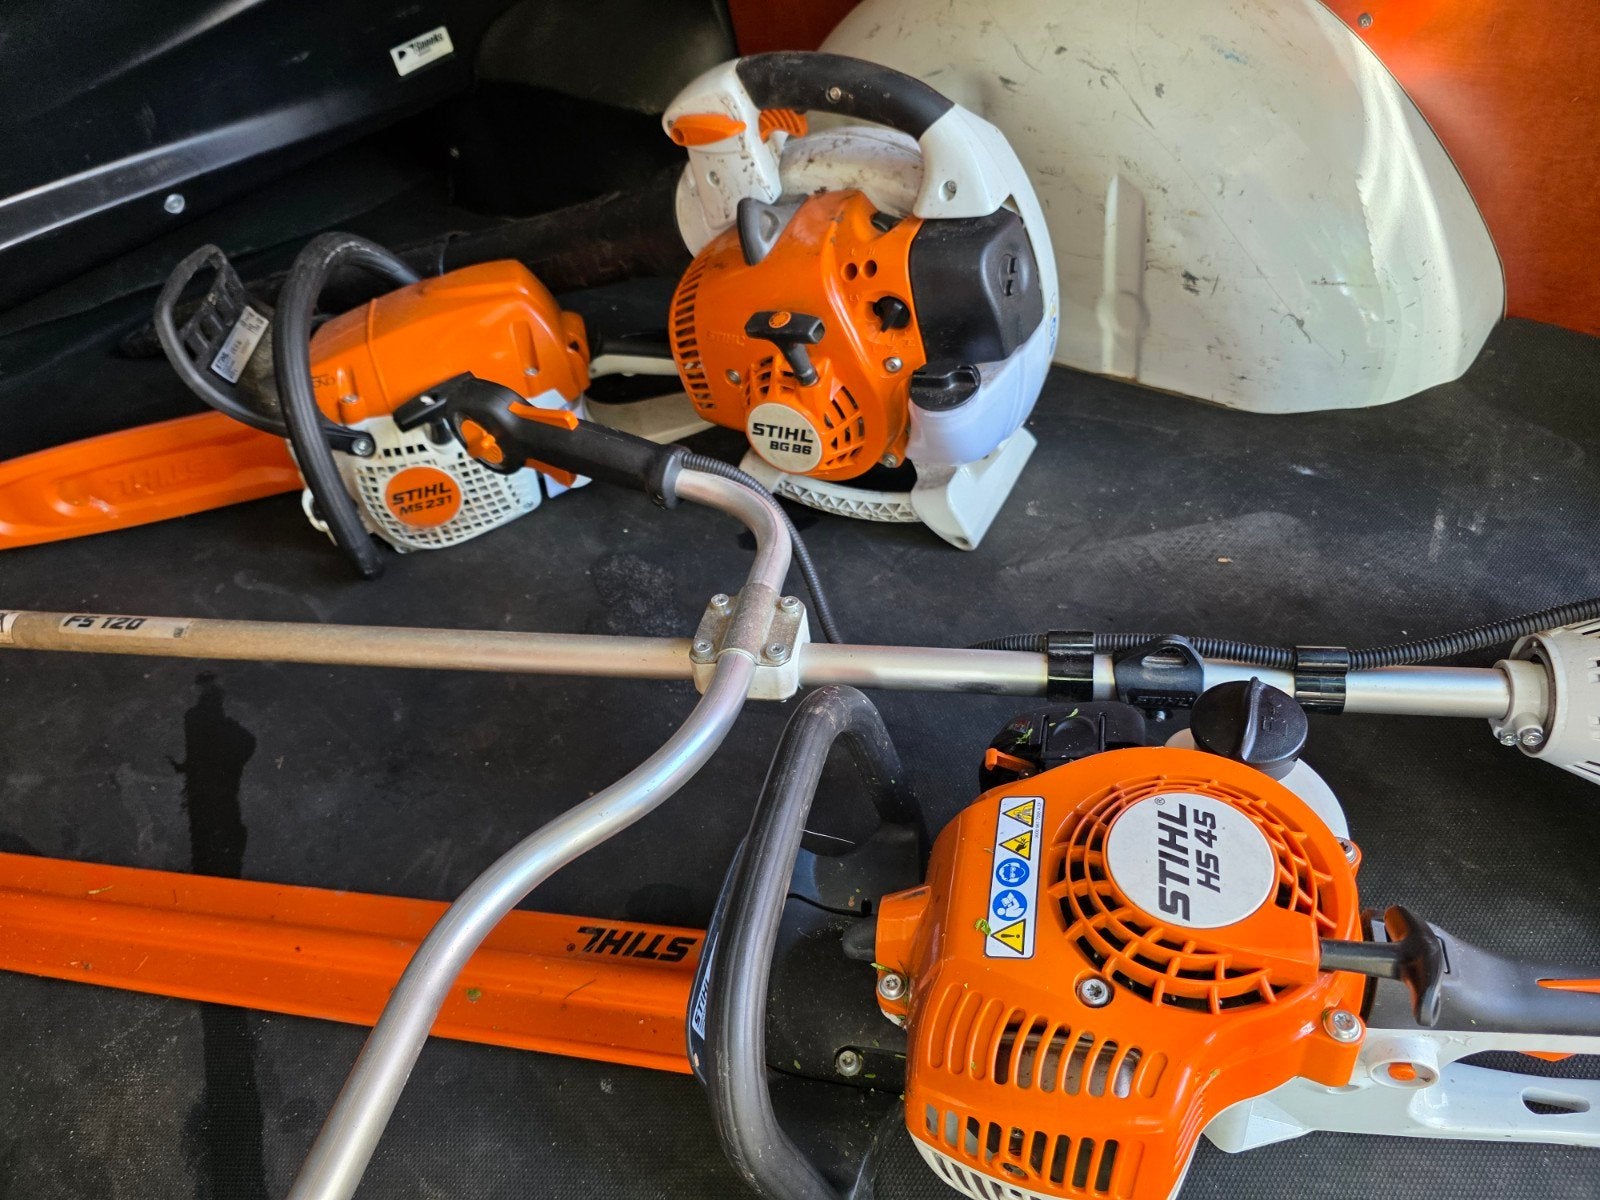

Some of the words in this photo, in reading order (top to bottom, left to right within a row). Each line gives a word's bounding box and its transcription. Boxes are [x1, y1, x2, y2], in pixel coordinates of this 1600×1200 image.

[752, 422, 814, 443] STIHL
[769, 440, 790, 452] BG
[791, 443, 812, 455] 86
[392, 482, 452, 506] STIHL
[400, 502, 423, 516] MS
[425, 494, 453, 510] 231
[62, 614, 98, 628] FS
[100, 616, 148, 631] 120
[1192, 808, 1218, 849] 45
[1157, 803, 1190, 922] STIHL
[1195, 849, 1221, 894] HS
[577, 926, 698, 963] STIHL
